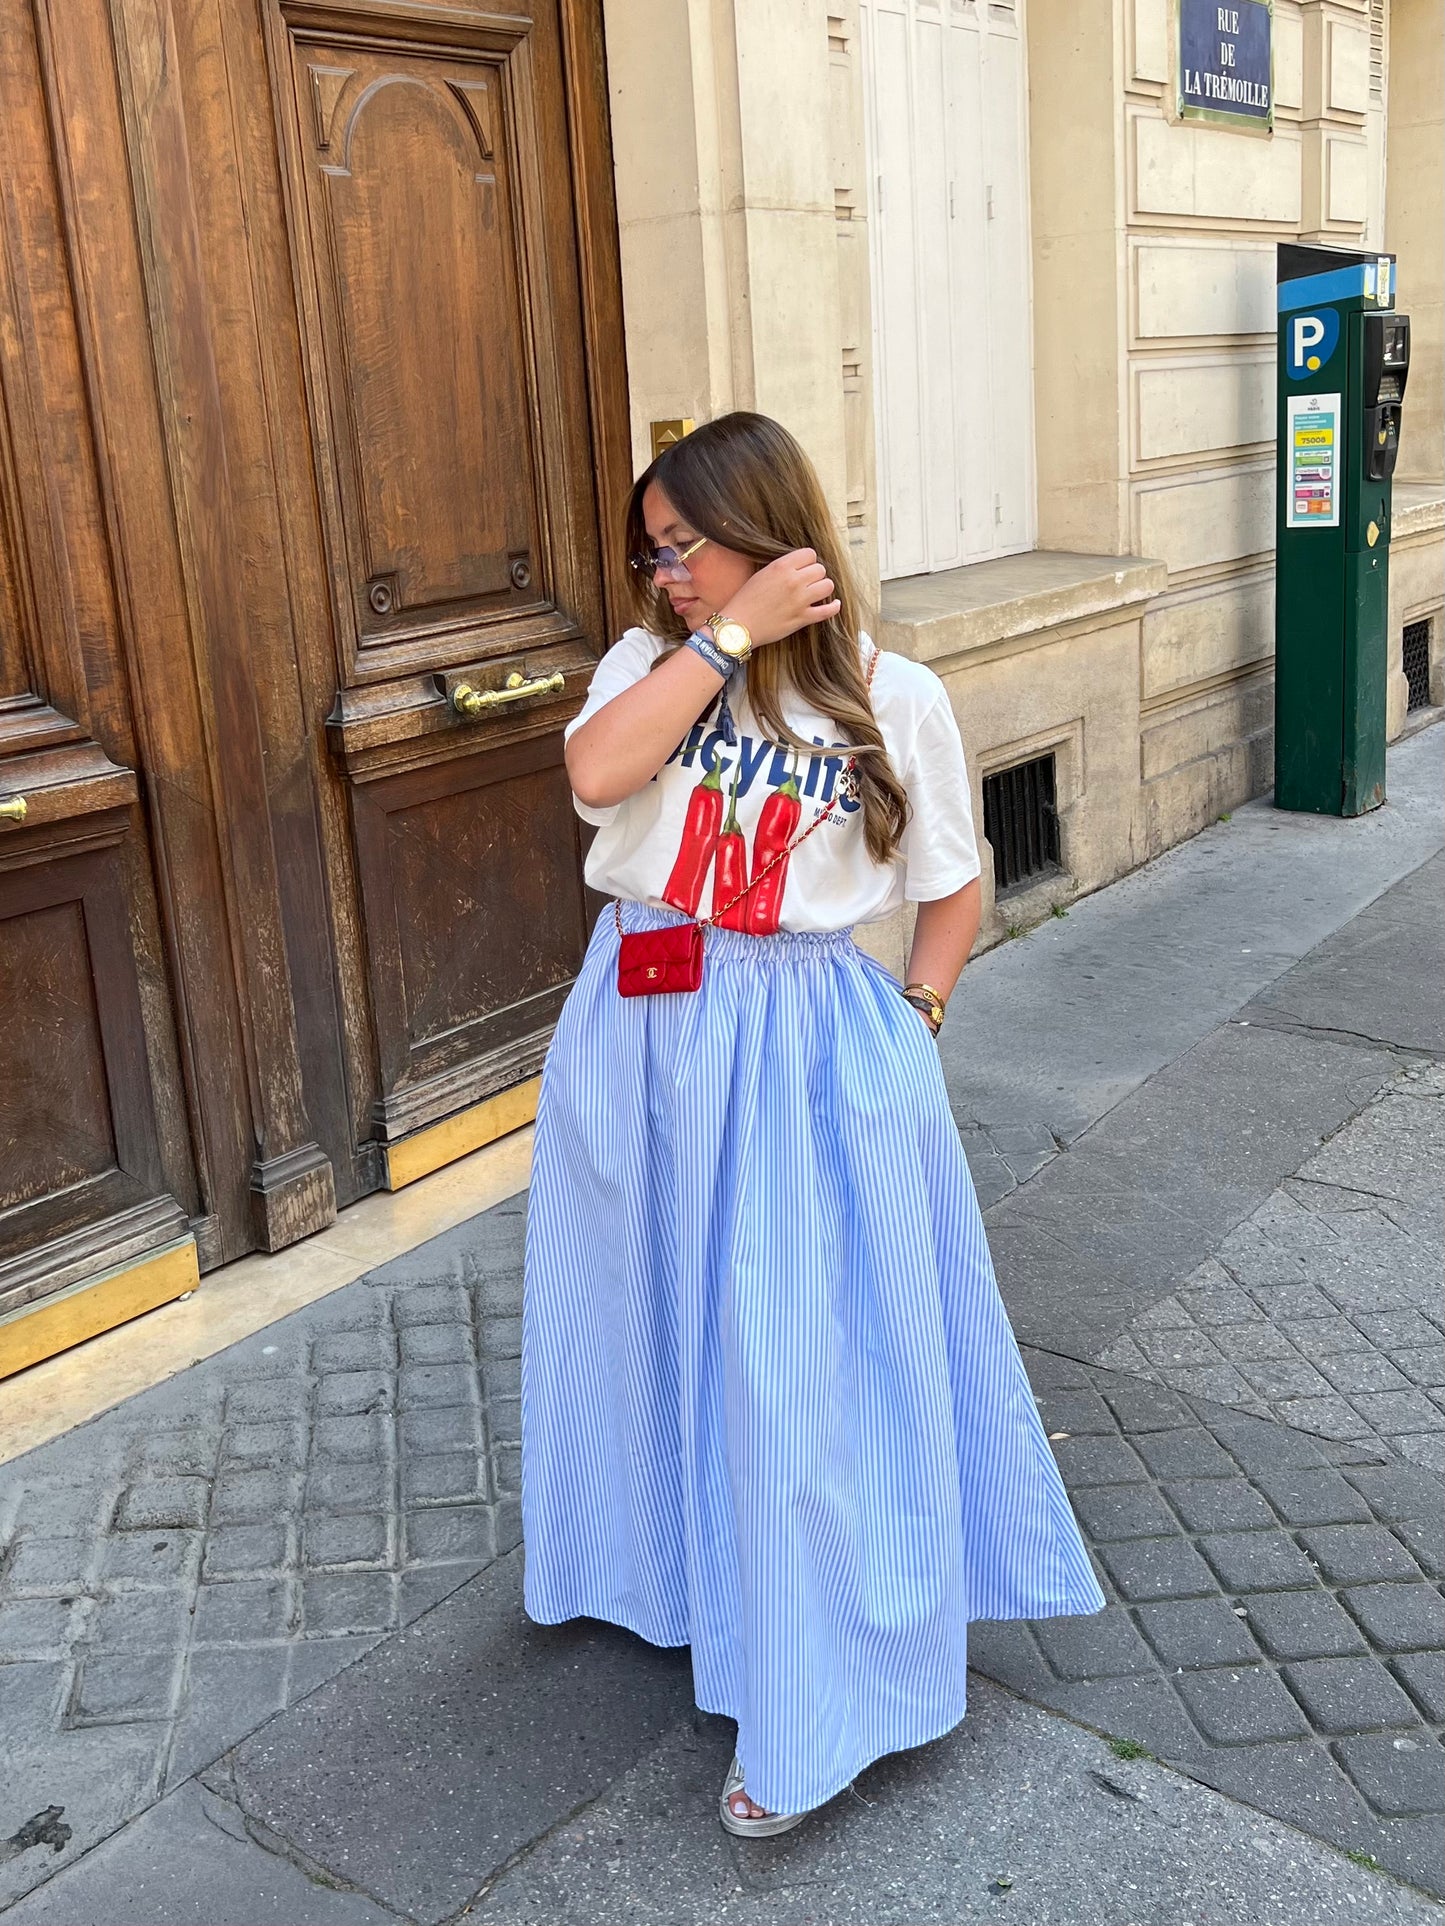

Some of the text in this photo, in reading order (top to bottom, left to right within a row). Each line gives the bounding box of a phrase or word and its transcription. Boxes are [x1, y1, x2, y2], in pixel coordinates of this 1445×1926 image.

[1217, 7, 1239, 35] RUE
[1220, 42, 1236, 67] DE
[1184, 69, 1268, 108] LA TRÉMOILLE
[1294, 316, 1325, 367] P
[1301, 436, 1327, 444] 75008
[700, 641, 729, 670] CHRISTIAN
